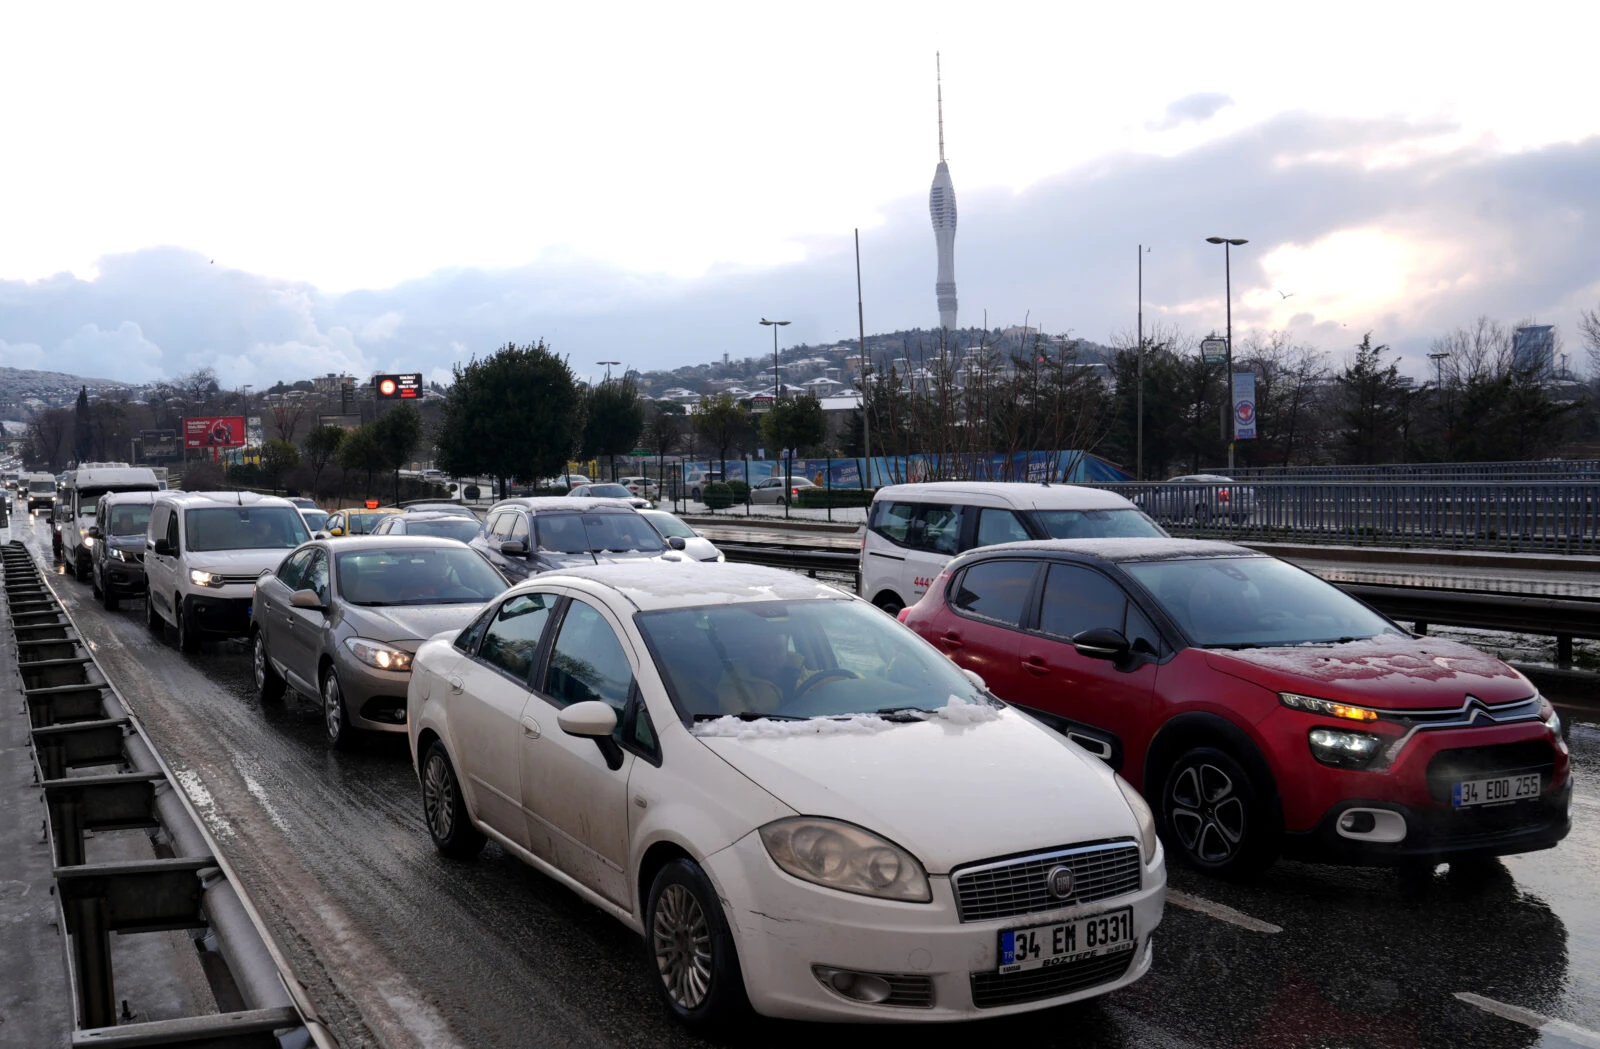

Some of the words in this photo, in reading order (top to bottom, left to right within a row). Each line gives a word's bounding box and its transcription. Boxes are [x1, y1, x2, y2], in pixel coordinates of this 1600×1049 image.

[1463, 783, 1478, 802] 34
[1516, 775, 1538, 796] 255
[1004, 951, 1014, 960] TR
[1015, 931, 1040, 961] 34
[1052, 924, 1076, 955] EM
[1086, 913, 1128, 948] 8331
[1042, 950, 1098, 967] BOZTEPE
